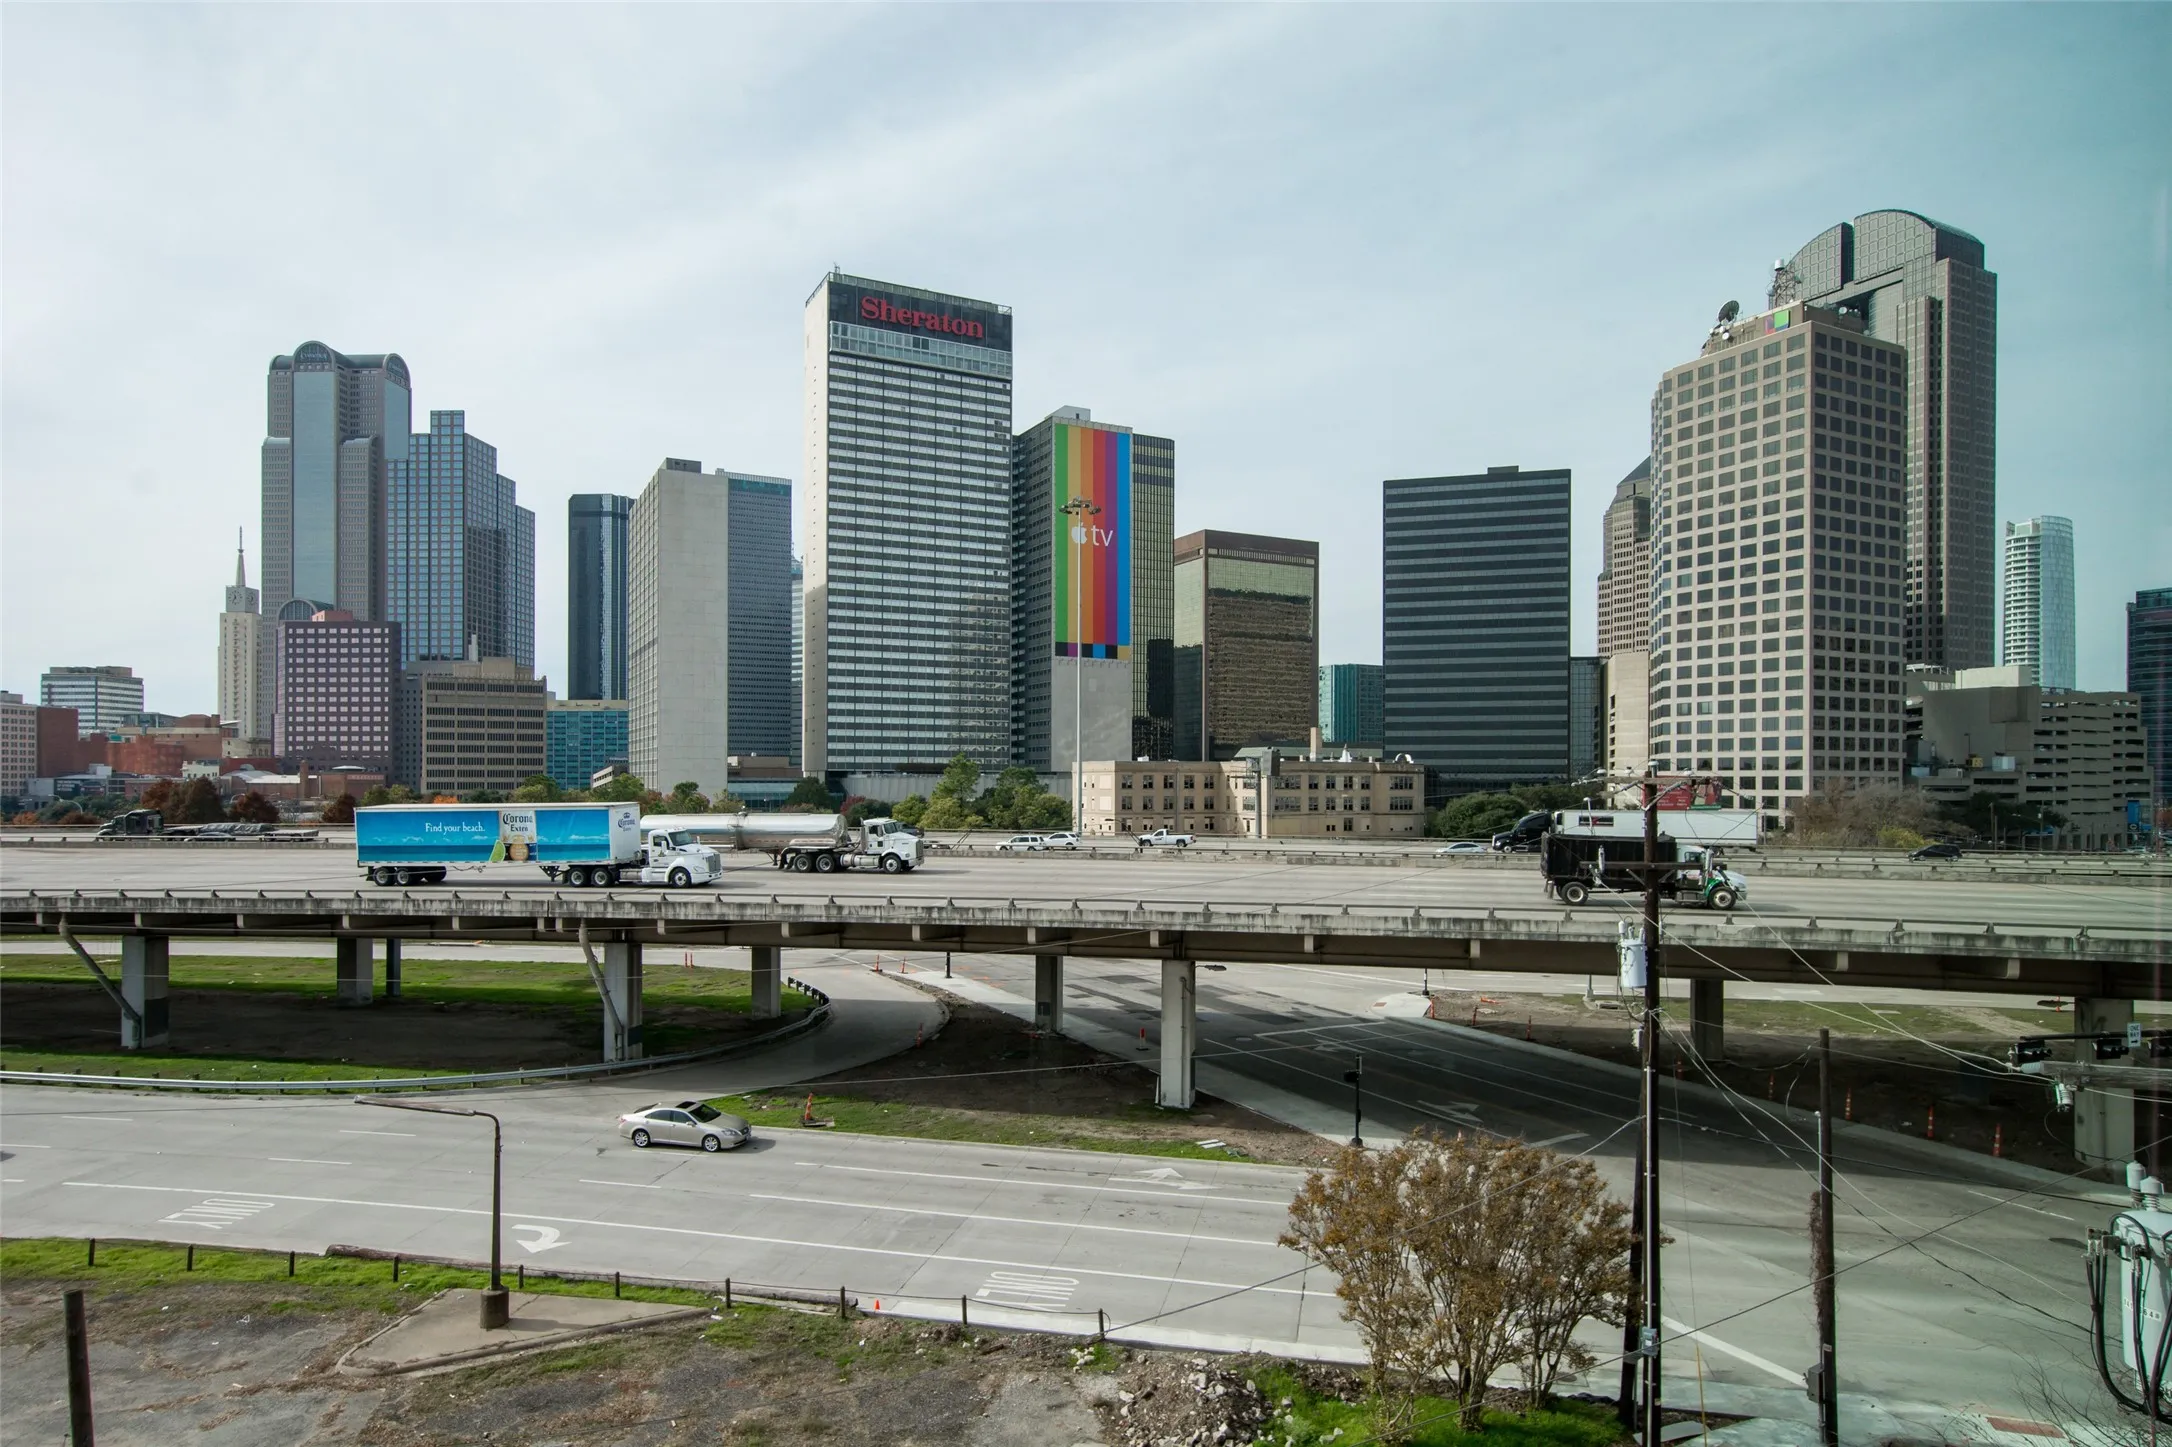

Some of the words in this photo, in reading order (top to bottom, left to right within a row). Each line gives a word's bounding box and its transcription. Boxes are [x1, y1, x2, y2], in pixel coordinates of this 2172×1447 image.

[861, 296, 983, 338] Sheraton
[1091, 525, 1113, 546] tv
[425, 822, 442, 832] Find
[443, 824, 461, 835] your
[462, 821, 485, 832] beach.
[503, 813, 533, 826] Corona
[617, 818, 636, 828] Corona
[158, 1198, 275, 1229] ONLY
